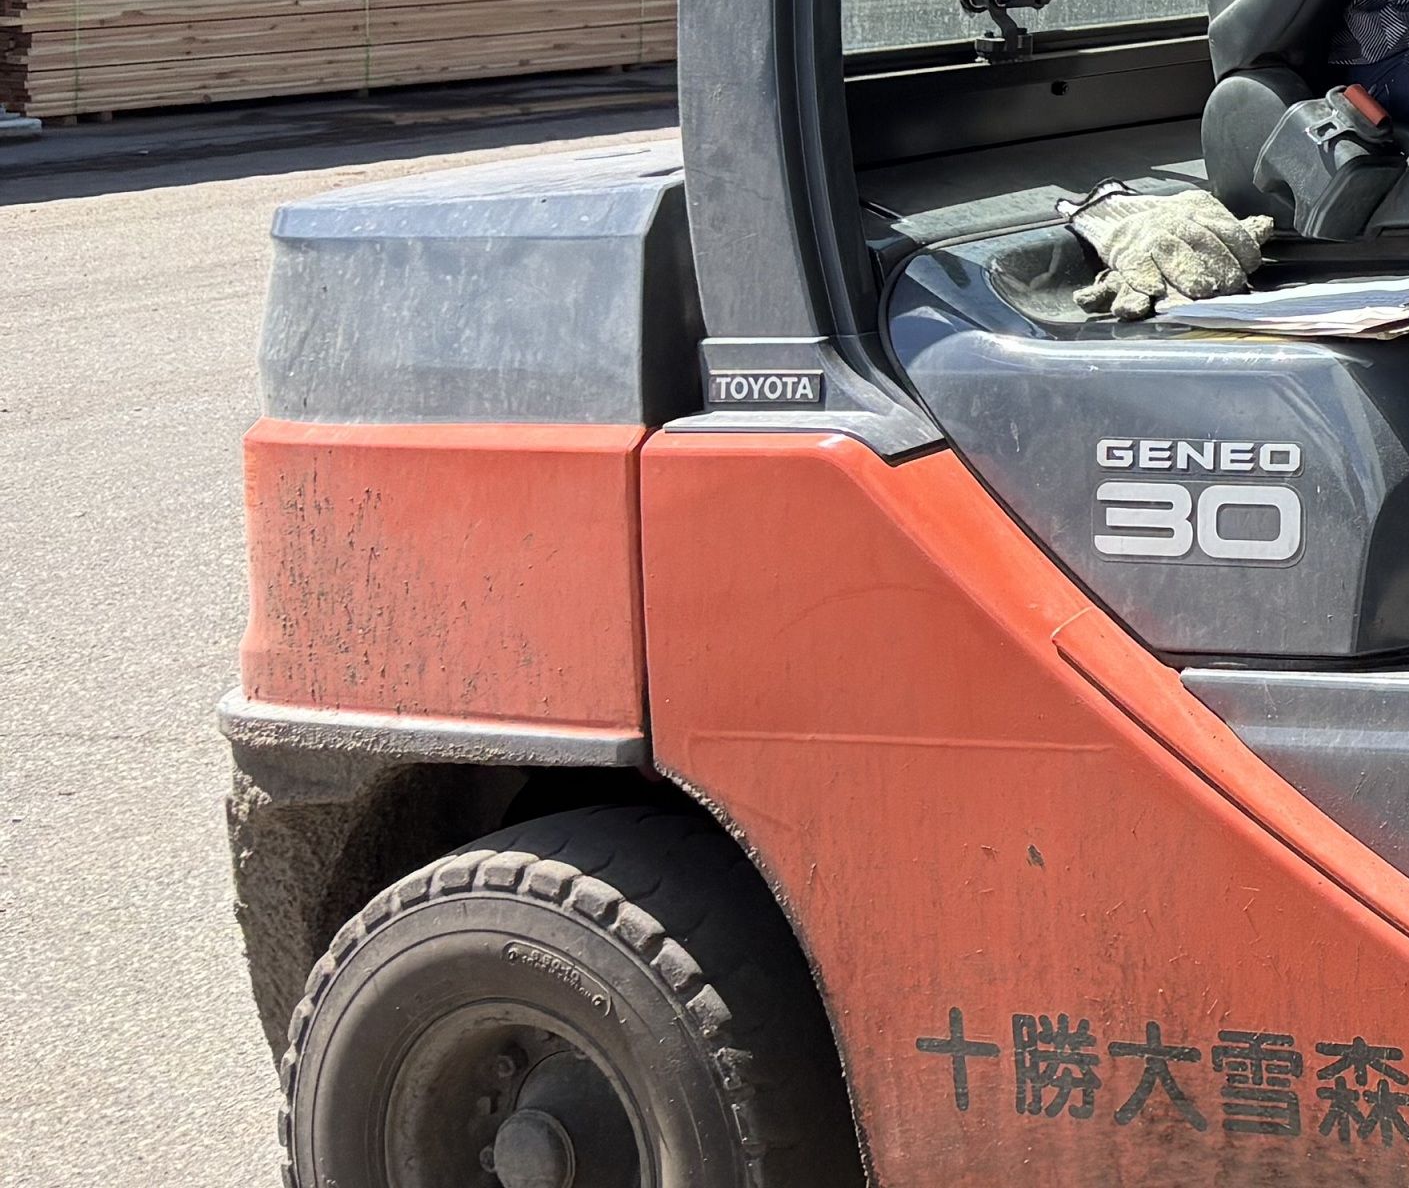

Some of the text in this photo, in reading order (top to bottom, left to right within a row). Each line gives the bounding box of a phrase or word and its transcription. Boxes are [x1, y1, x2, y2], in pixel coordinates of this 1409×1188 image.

[715, 376, 814, 401] TOYOTA
[1097, 439, 1301, 471] GENEO
[1095, 483, 1301, 560] 30
